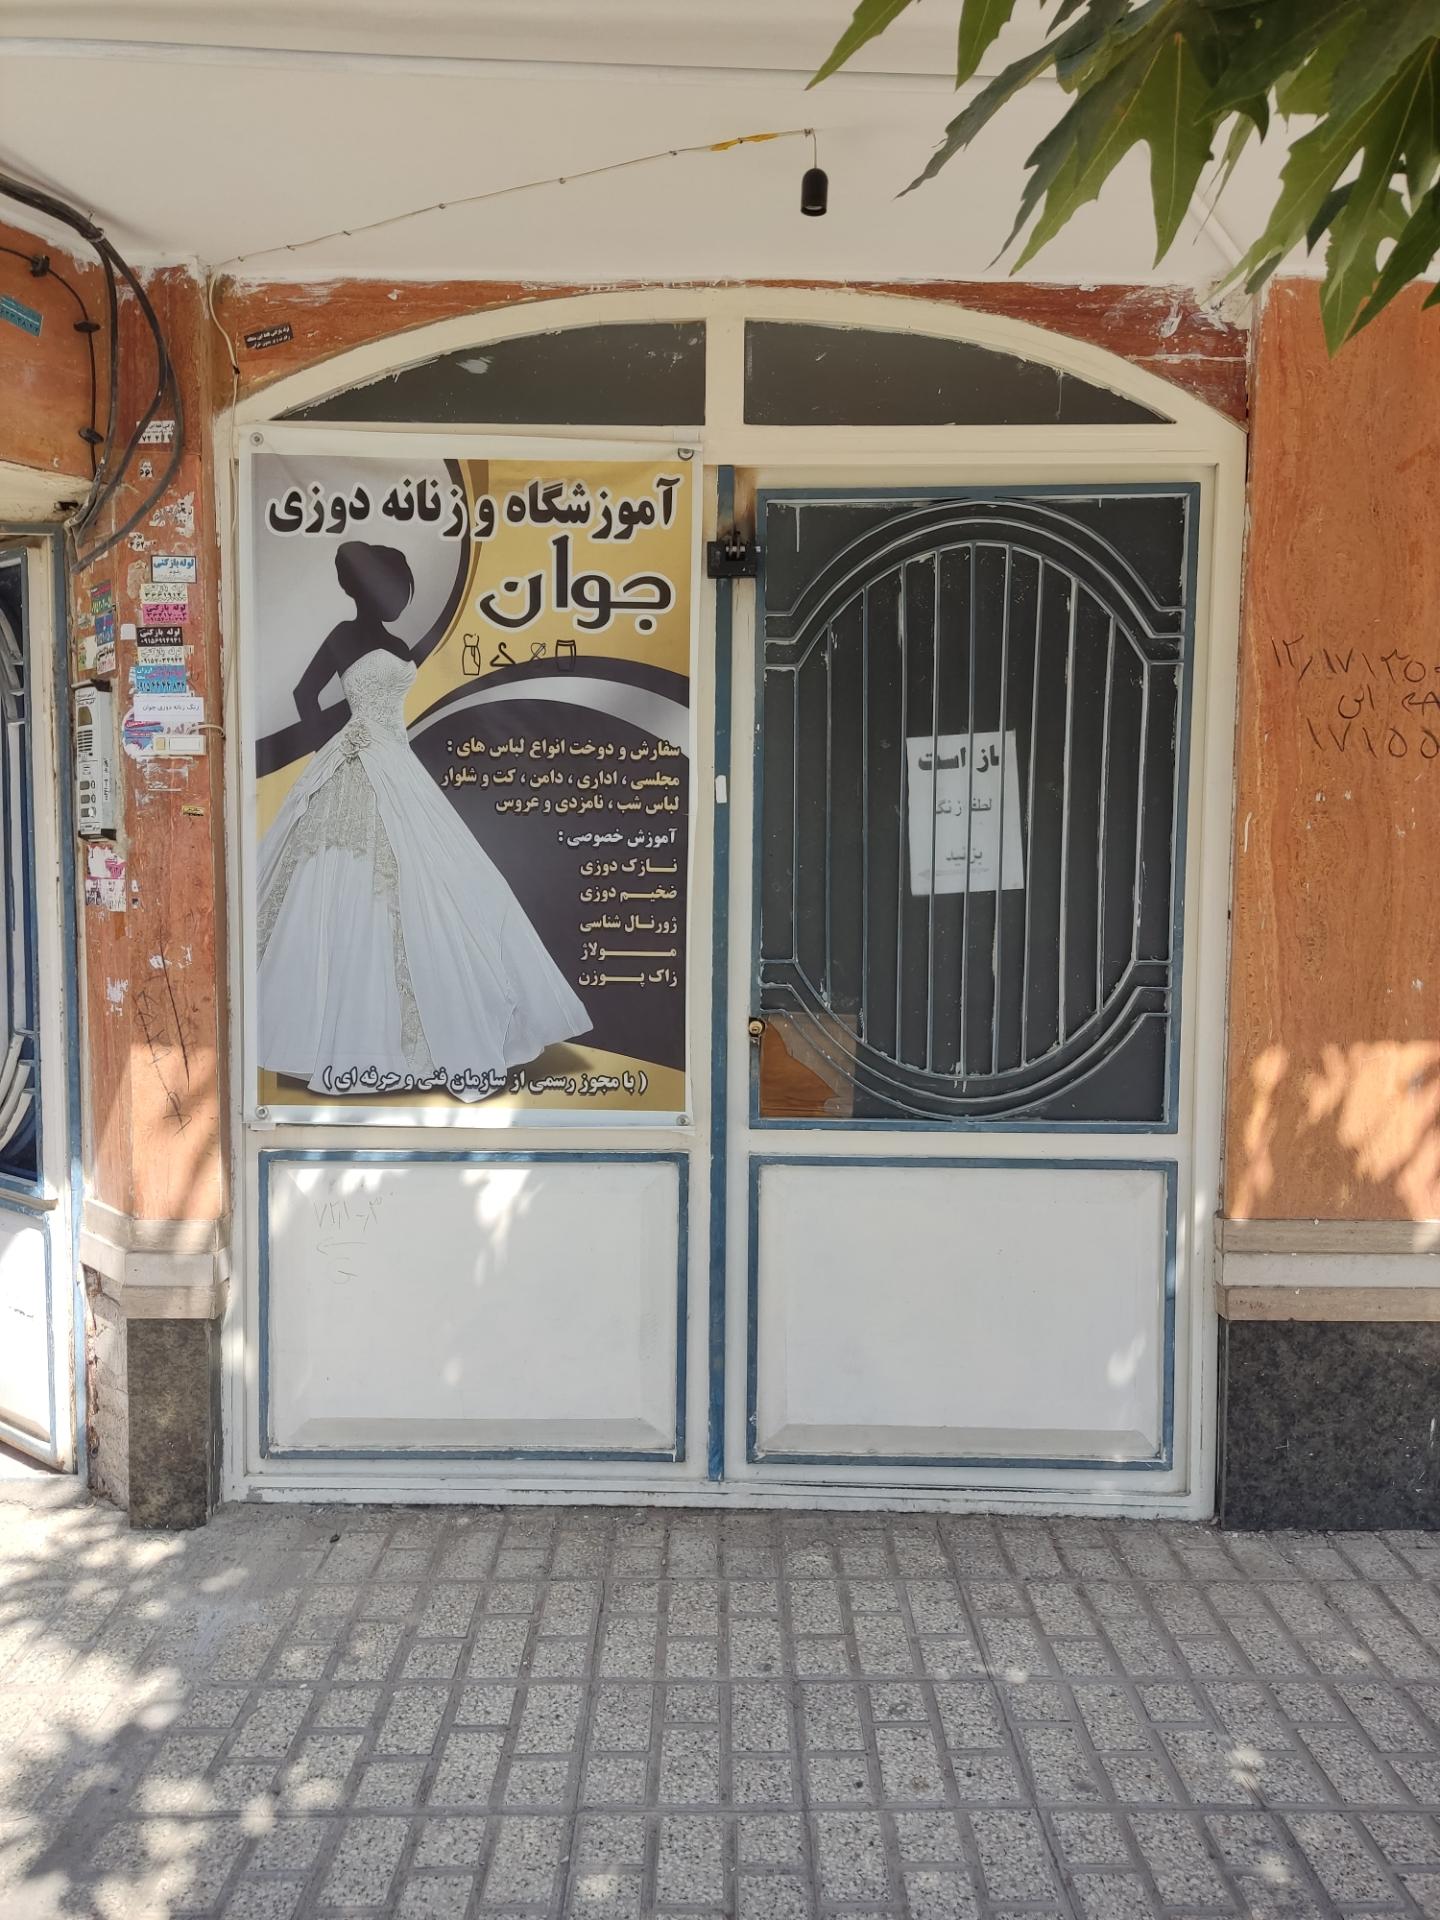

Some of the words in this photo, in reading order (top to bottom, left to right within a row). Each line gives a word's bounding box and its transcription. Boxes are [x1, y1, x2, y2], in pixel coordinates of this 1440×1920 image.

[269, 486, 370, 534] دوزی
[382, 479, 464, 536] زنانه
[507, 477, 679, 539] آموزشگاه
[475, 499, 493, 537] و
[480, 536, 671, 630] جوان
[490, 738, 525, 759] لباس
[530, 739, 565, 759] انواع
[569, 740, 614, 759] دوخت
[618, 745, 626, 759] و
[630, 740, 681, 760] سفارش
[441, 767, 477, 787] شلوار
[481, 773, 489, 789] و
[493, 768, 517, 785] کت
[529, 770, 563, 790] دامن
[577, 770, 617, 790] اداری
[630, 771, 680, 791] مجلسی
[496, 796, 539, 815] عروس
[543, 800, 550, 813] و
[555, 794, 603, 815] نامزدی
[645, 796, 679, 815] لباس
[627, 828, 677, 848] آموزش
[580, 858, 617, 876] دوزی
[580, 885, 616, 903] دوزی
[579, 914, 621, 933] شناسی
[404, 1074, 413, 1090] و
[417, 1067, 448, 1090] فنی
[450, 1068, 507, 1094] سازمان
[510, 1070, 526, 1093] از
[529, 1072, 576, 1096] رسمی
[579, 1072, 619, 1096] مجوز
